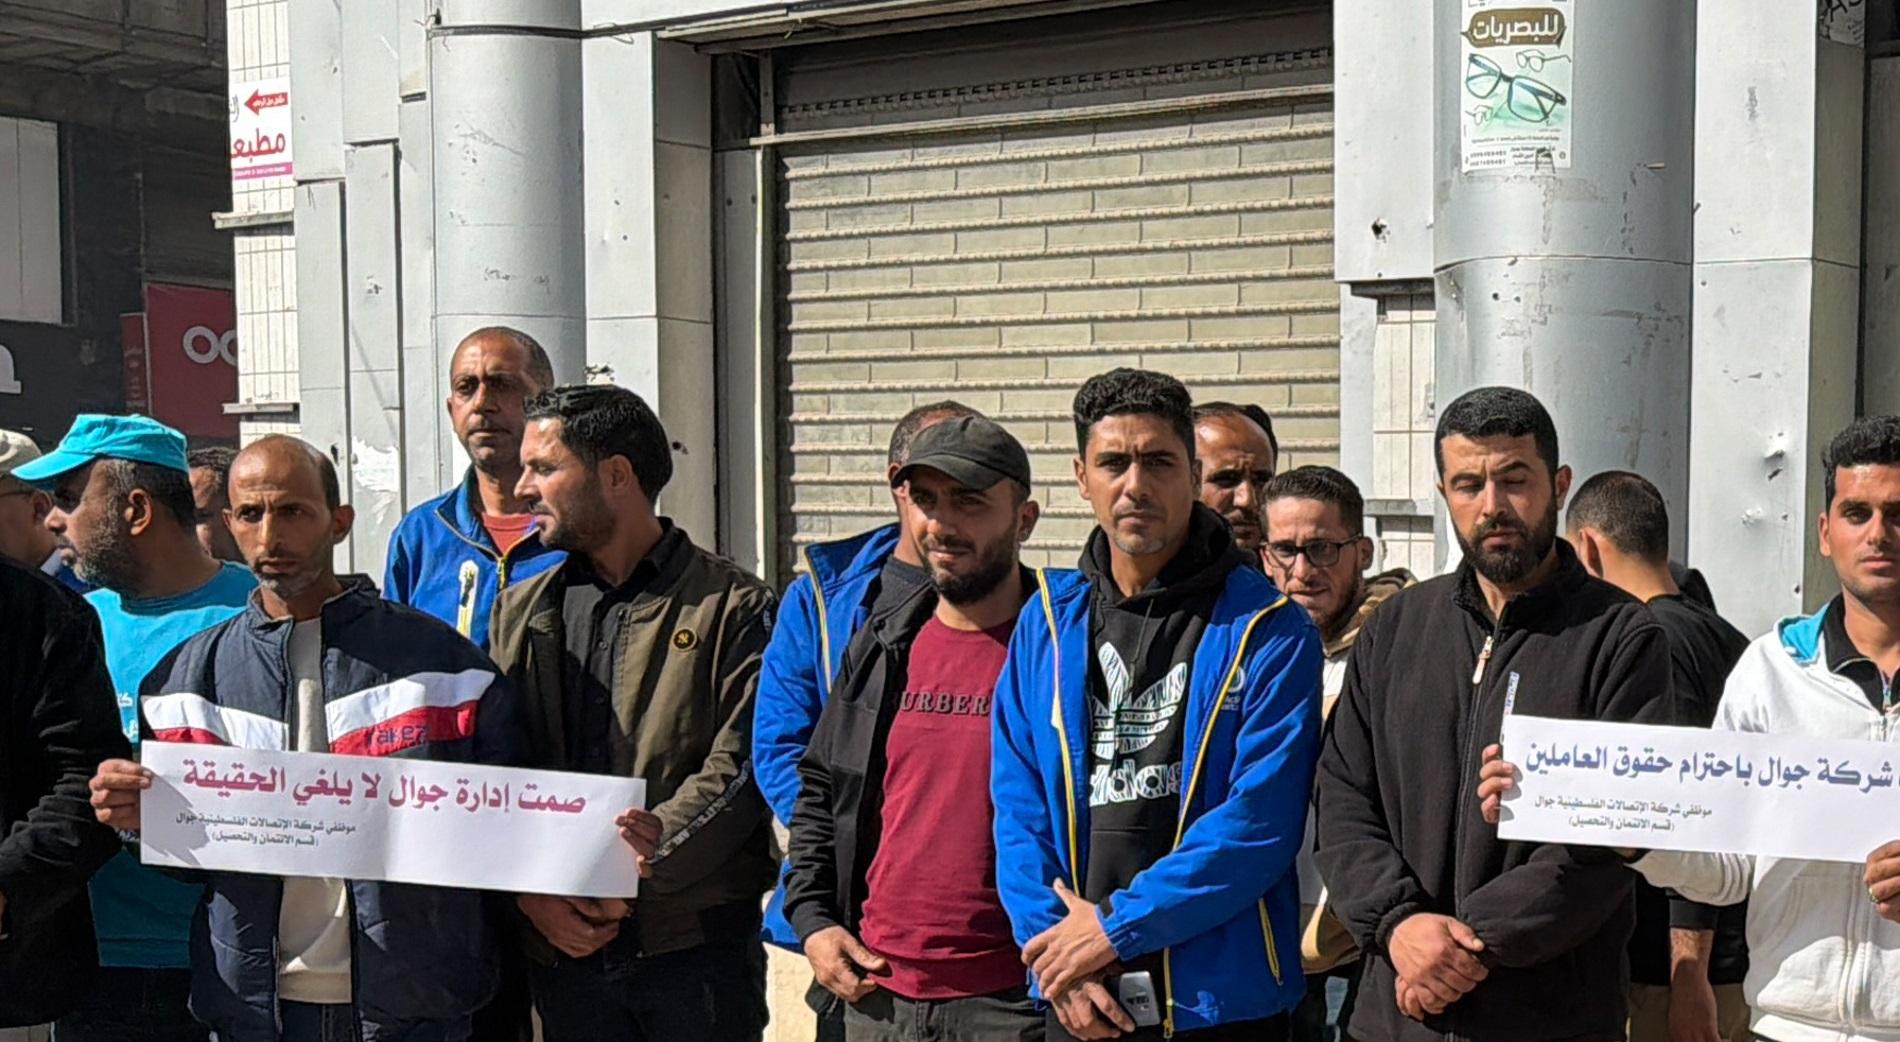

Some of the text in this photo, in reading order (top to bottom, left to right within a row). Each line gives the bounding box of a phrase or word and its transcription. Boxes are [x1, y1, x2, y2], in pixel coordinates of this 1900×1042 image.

[1473, 14, 1558, 44] للبصريات
[231, 127, 286, 164] مطبع
[1526, 742, 1608, 776] العاملين
[1613, 746, 1673, 779] حقوق
[1679, 751, 1752, 787] باحترام
[1758, 756, 1810, 790] جوال
[1817, 758, 1893, 793] شركة
[182, 759, 586, 813] صمت إدارة جوال لا يلغي الحقيقة
